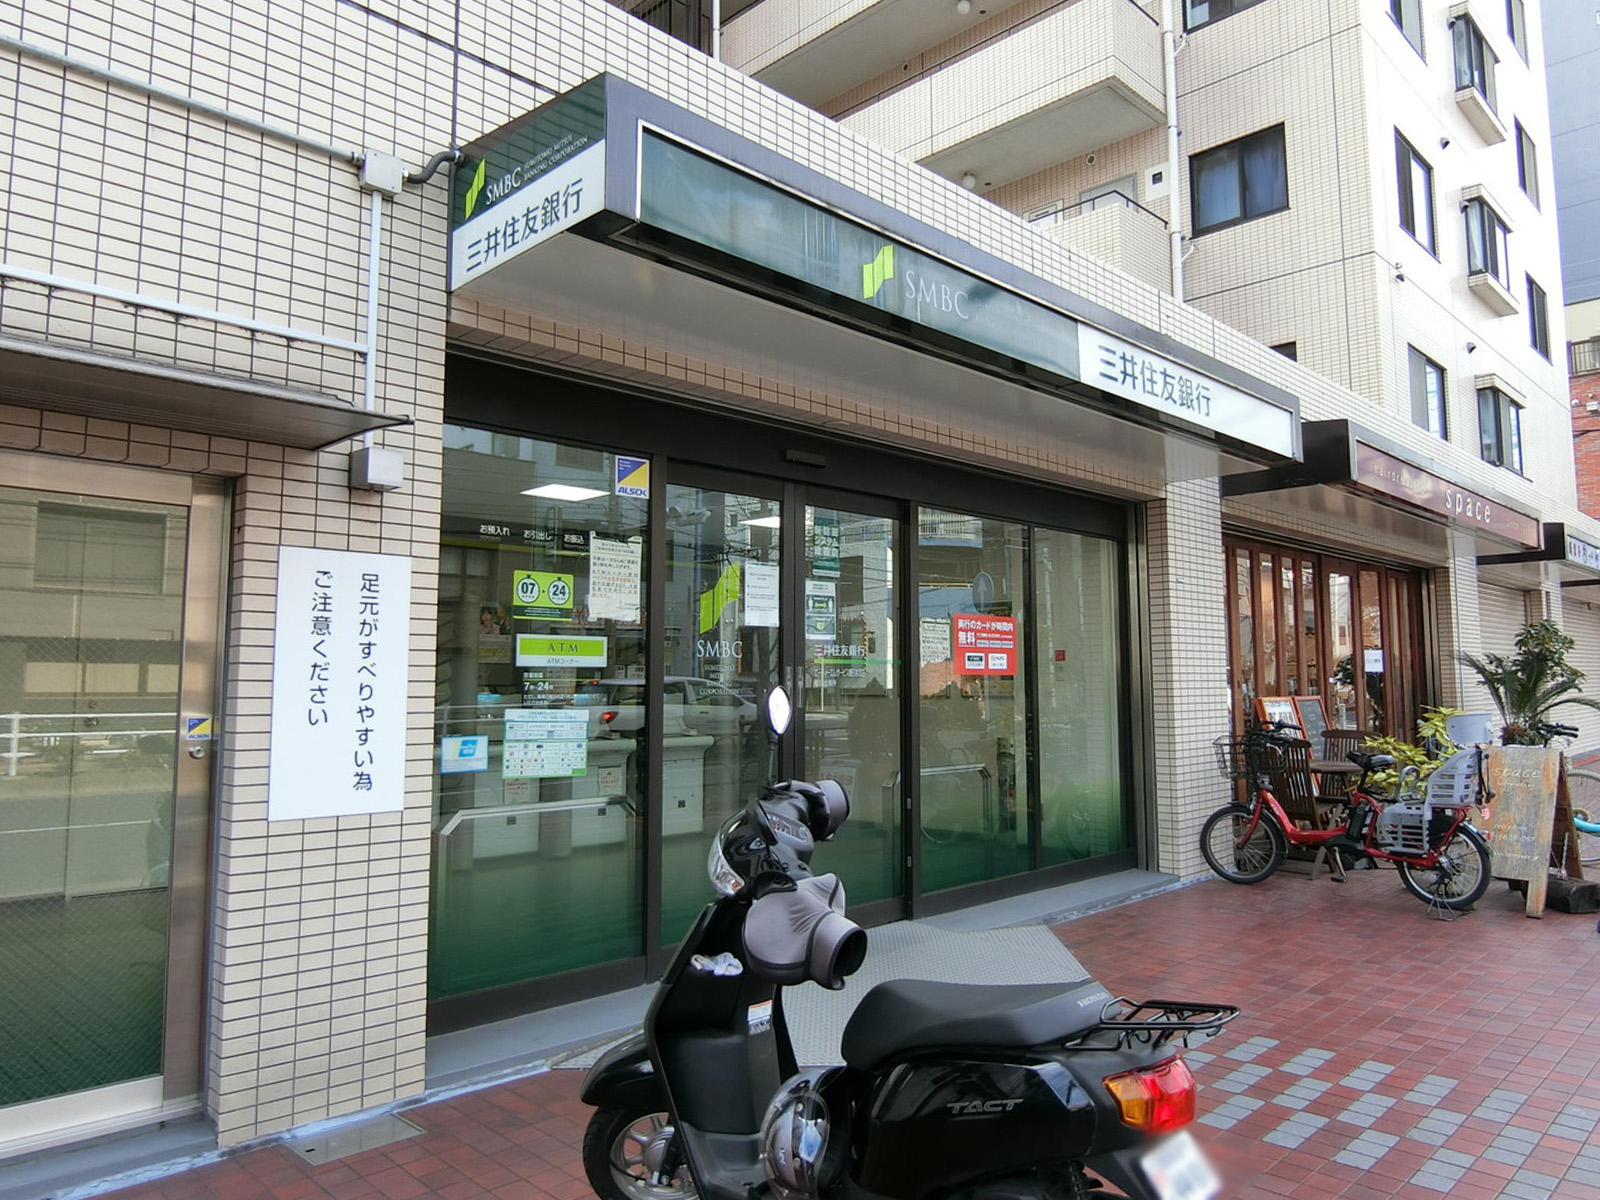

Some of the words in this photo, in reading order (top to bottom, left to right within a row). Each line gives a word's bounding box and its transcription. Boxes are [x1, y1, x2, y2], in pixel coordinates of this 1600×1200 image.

[486, 167, 522, 205] SMBC
[466, 178, 583, 272] 三井住友銀行
[905, 270, 969, 320] SMBC
[1098, 344, 1211, 417] 三井住友銀行
[618, 486, 648, 497] ALSOK
[1445, 488, 1491, 523] space
[521, 582, 535, 594] 07
[552, 584, 566, 597] 24
[308, 570, 334, 726] ご注意ください
[697, 639, 743, 658] SMBC
[814, 644, 866, 657] 三井住友銀行
[353, 573, 380, 791] 足元がすべりやすい為
[946, 1098, 1024, 1114] TACT
